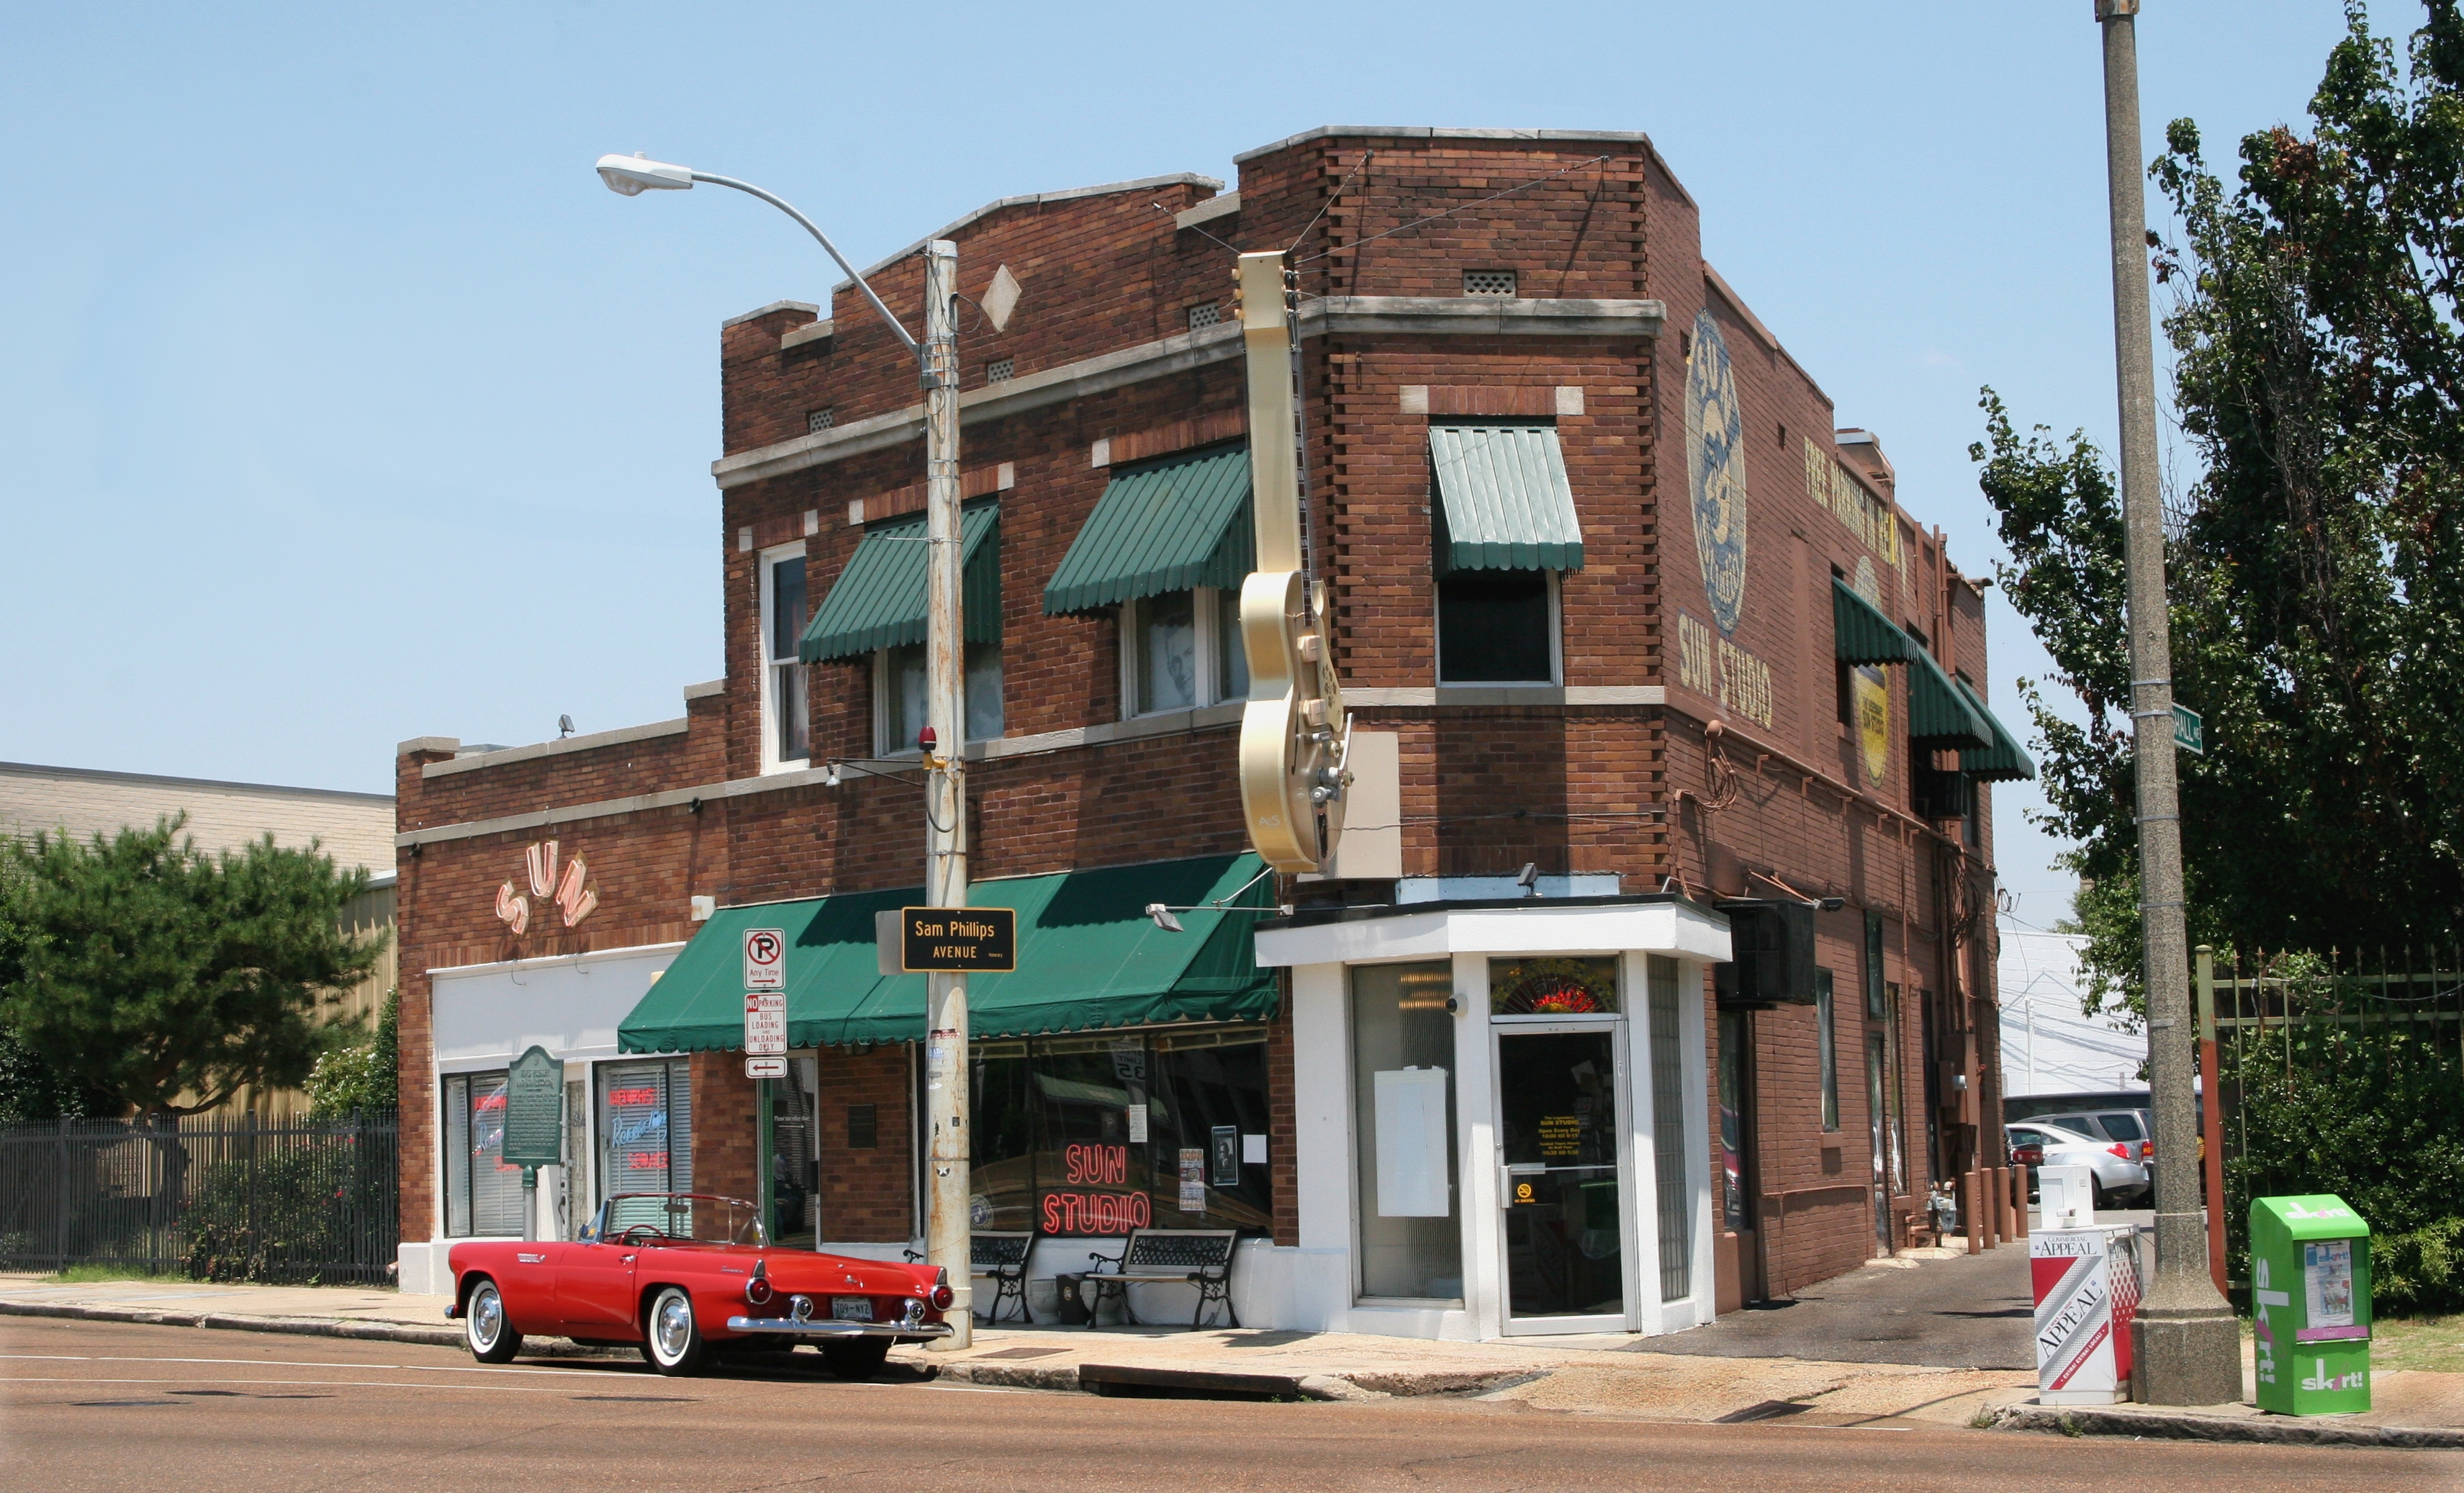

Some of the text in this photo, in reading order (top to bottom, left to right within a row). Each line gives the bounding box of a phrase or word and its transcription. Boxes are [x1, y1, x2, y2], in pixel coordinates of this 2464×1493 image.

[1697, 336, 1733, 430] SUN
[1805, 436, 1828, 508] FREE
[1831, 460, 1865, 543] PARKING
[1678, 613, 1772, 731] SUN STUDIO
[496, 840, 597, 935] SUN
[916, 921, 995, 941] Sam Phillips
[933, 946, 977, 958] AVENUE
[747, 998, 758, 1009] NO
[749, 1034, 785, 1043] UNLOADING
[752, 1021, 779, 1029] LOADING
[1067, 1145, 1125, 1183] SUN
[1044, 1191, 1150, 1233] STUDIO
[2285, 1201, 2351, 1219] skirt!
[2040, 1240, 2098, 1256] APPEAL
[2039, 1287, 2103, 1360] APPEAL
[2255, 1257, 2290, 1384] skirt!
[2063, 1332, 2103, 1379] EXTRA! EXTRA! LOCAL!
[2301, 1358, 2363, 1391] skirt!
